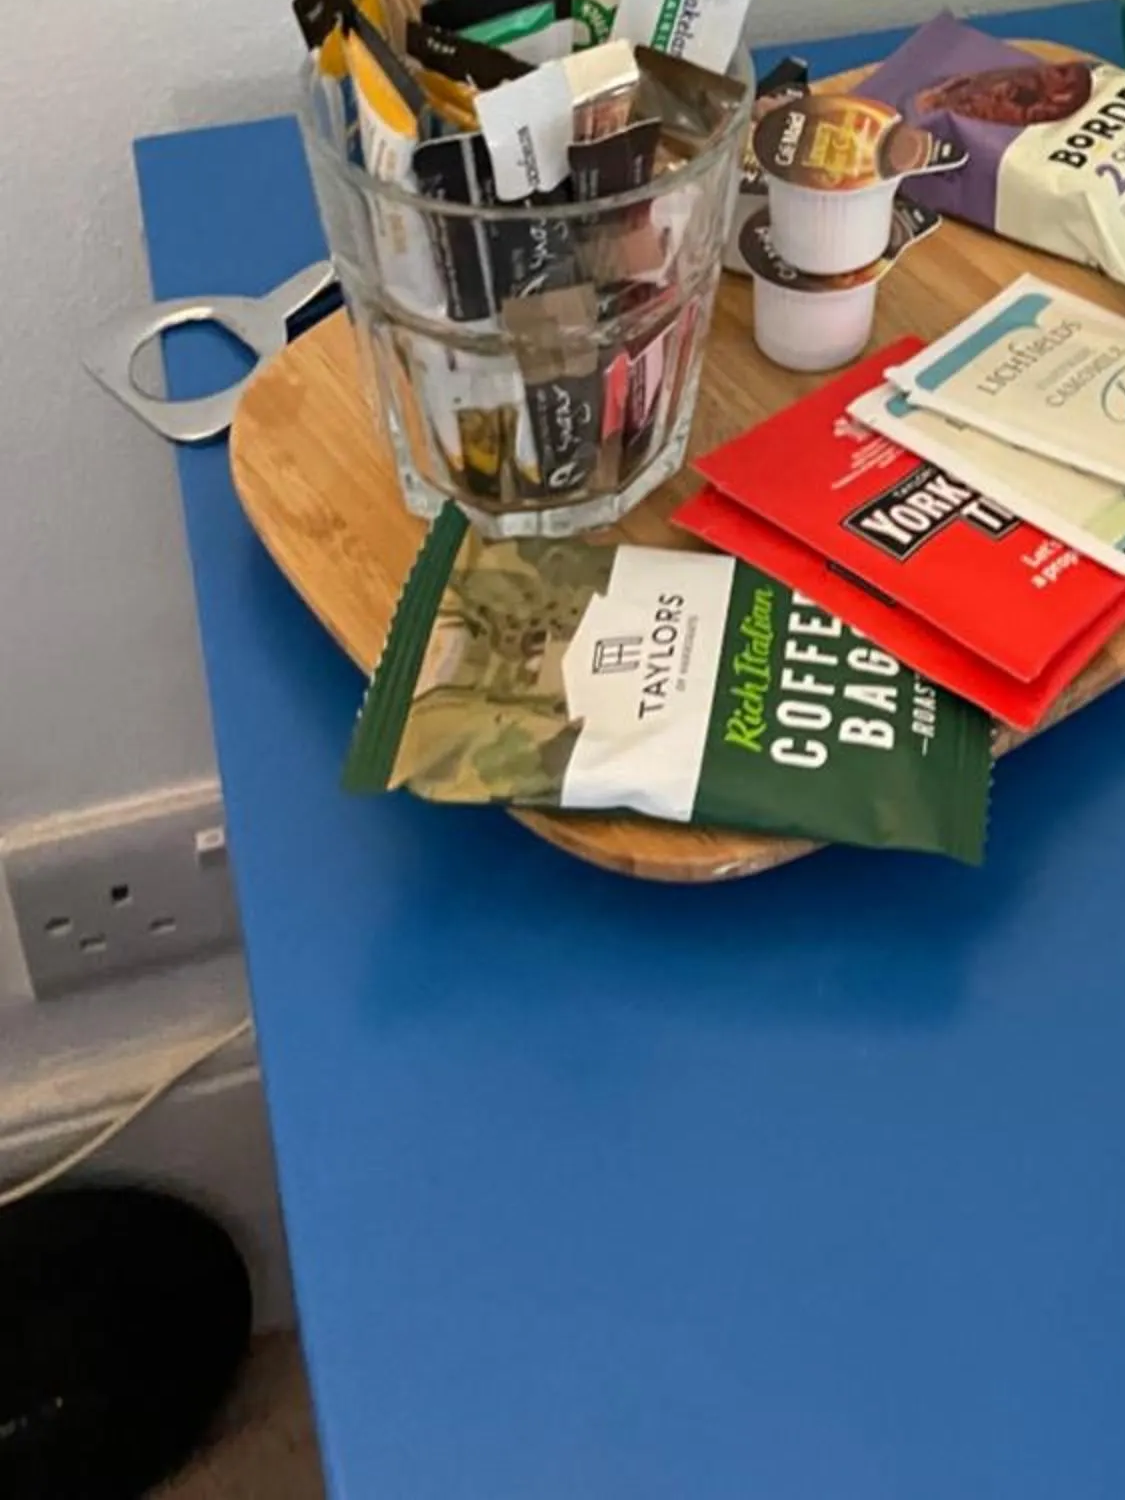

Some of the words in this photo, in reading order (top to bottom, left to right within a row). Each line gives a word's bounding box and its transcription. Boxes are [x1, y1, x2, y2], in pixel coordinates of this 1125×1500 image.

[638, 593, 684, 720] TAYLORS
[734, 585, 774, 684] Italian
[724, 679, 767, 752] Rich
[838, 624, 901, 750] BAG
[911, 672, 937, 738] ROAS
